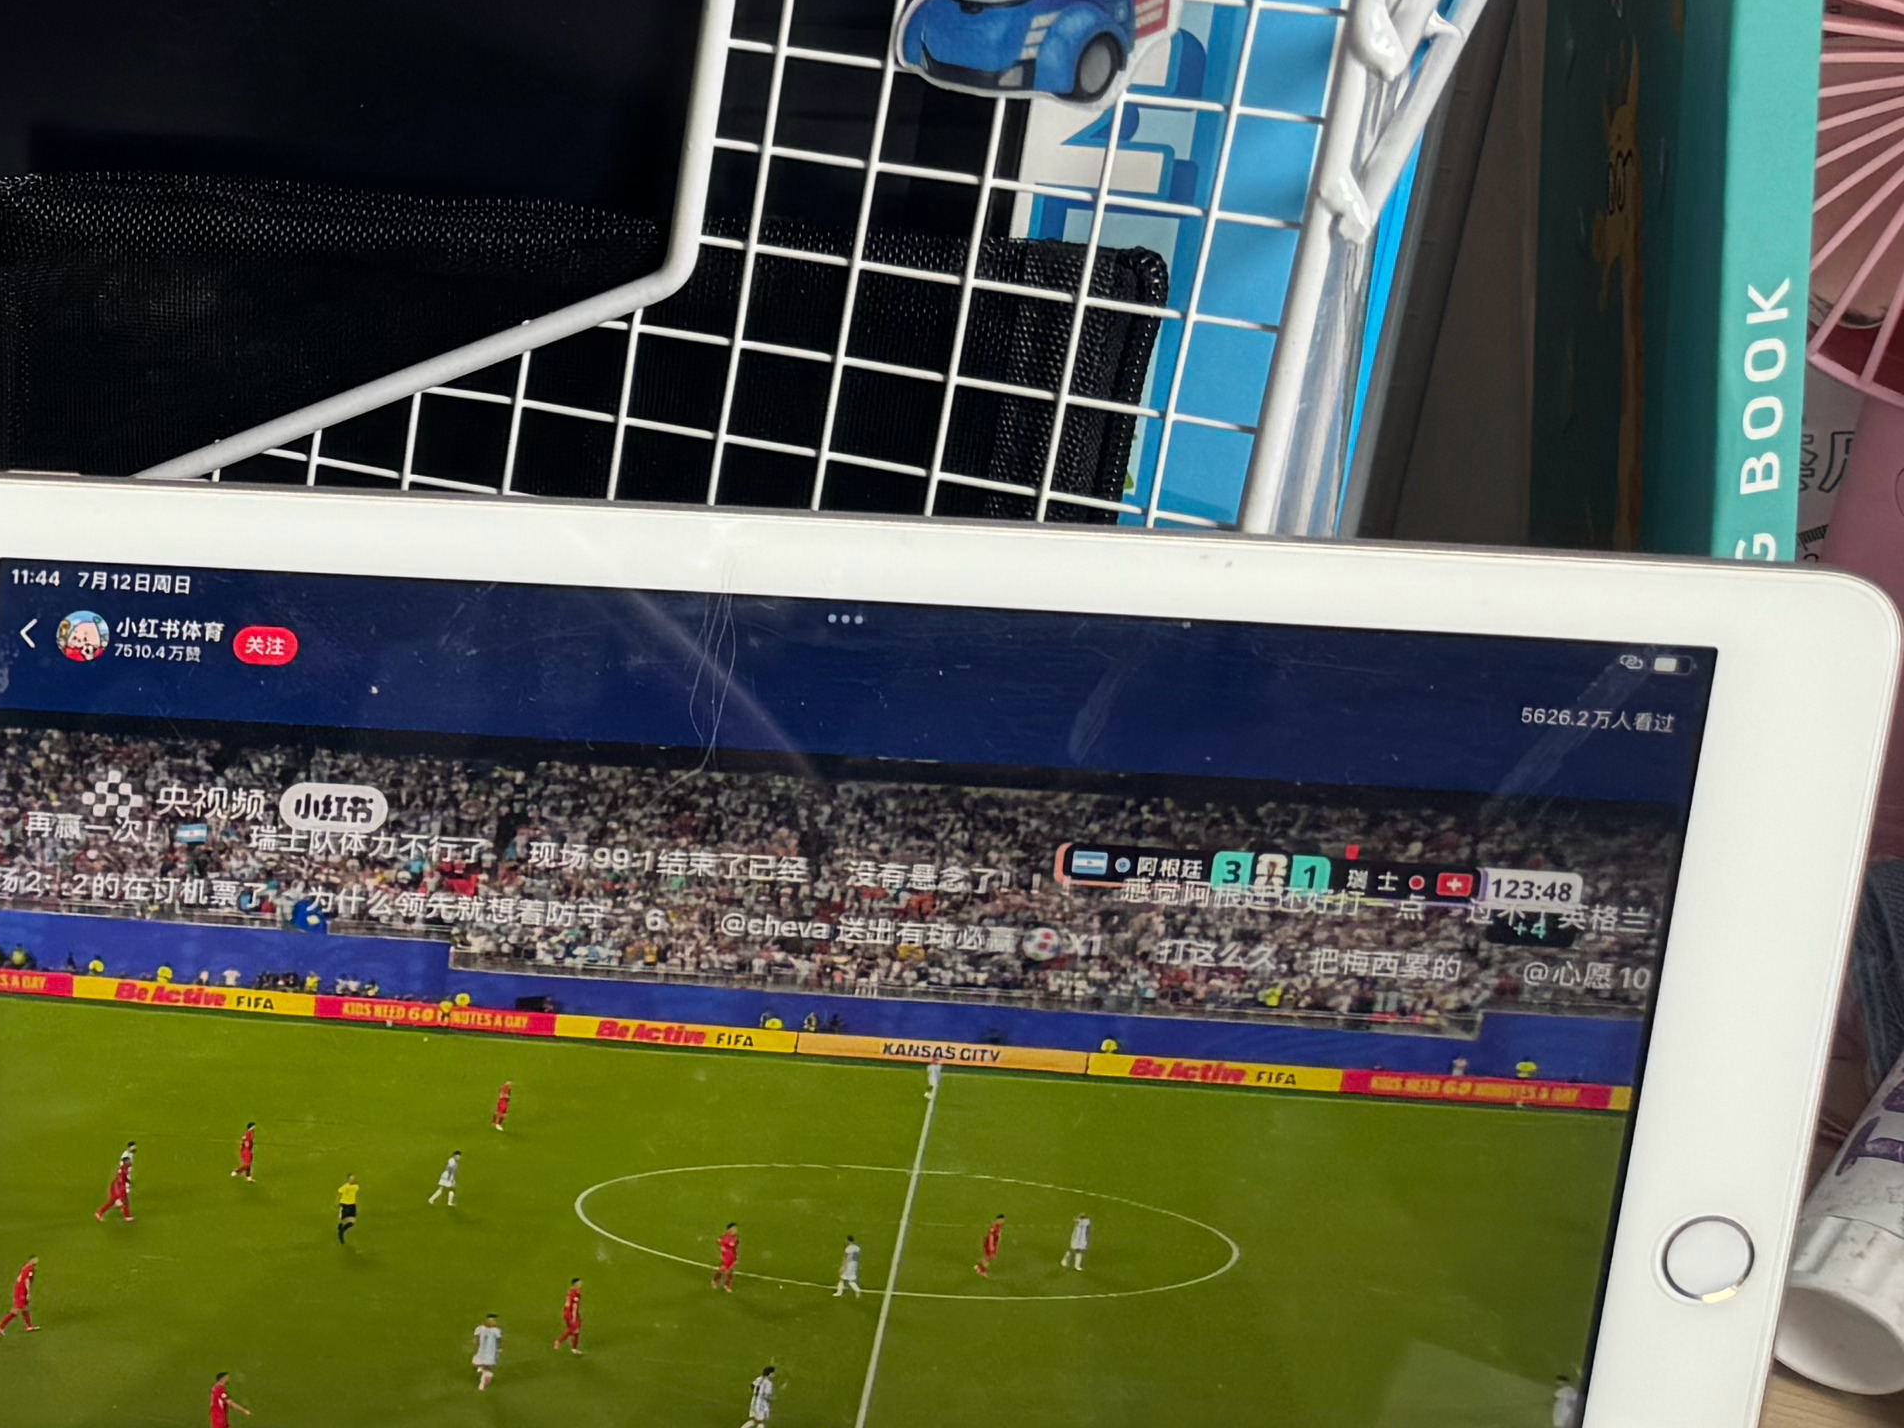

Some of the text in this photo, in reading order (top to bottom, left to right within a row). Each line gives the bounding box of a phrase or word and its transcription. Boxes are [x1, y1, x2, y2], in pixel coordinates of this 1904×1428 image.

[1739, 276, 1791, 495] BOOK
[11, 569, 191, 595] 11:44 7月12日周日
[116, 617, 225, 643] 小红书体育
[114, 643, 202, 662] 7510.4万赞
[245, 636, 286, 656] 关注
[1521, 706, 1677, 734] 5626.2万人看过
[156, 783, 266, 822] 央视频
[294, 793, 375, 823] 小红书
[249, 824, 491, 866] 瑞士队体力不行了
[1136, 856, 1242, 884] 阿根廷 3
[1303, 864, 1318, 889] 1
[1491, 878, 1574, 902] 123:48
[305, 884, 607, 930] 为什么领先就想着防守
[645, 908, 664, 932] 6
[114, 982, 275, 1011] Be Active FIFA
[342, 1001, 371, 1017] KIDS
[407, 1005, 435, 1023] 60
[595, 1019, 630, 1040] Be
[716, 1032, 755, 1049] FIFA
[882, 1042, 1002, 1063] KANSAS CITY
[1255, 1069, 1297, 1087] FIFA
